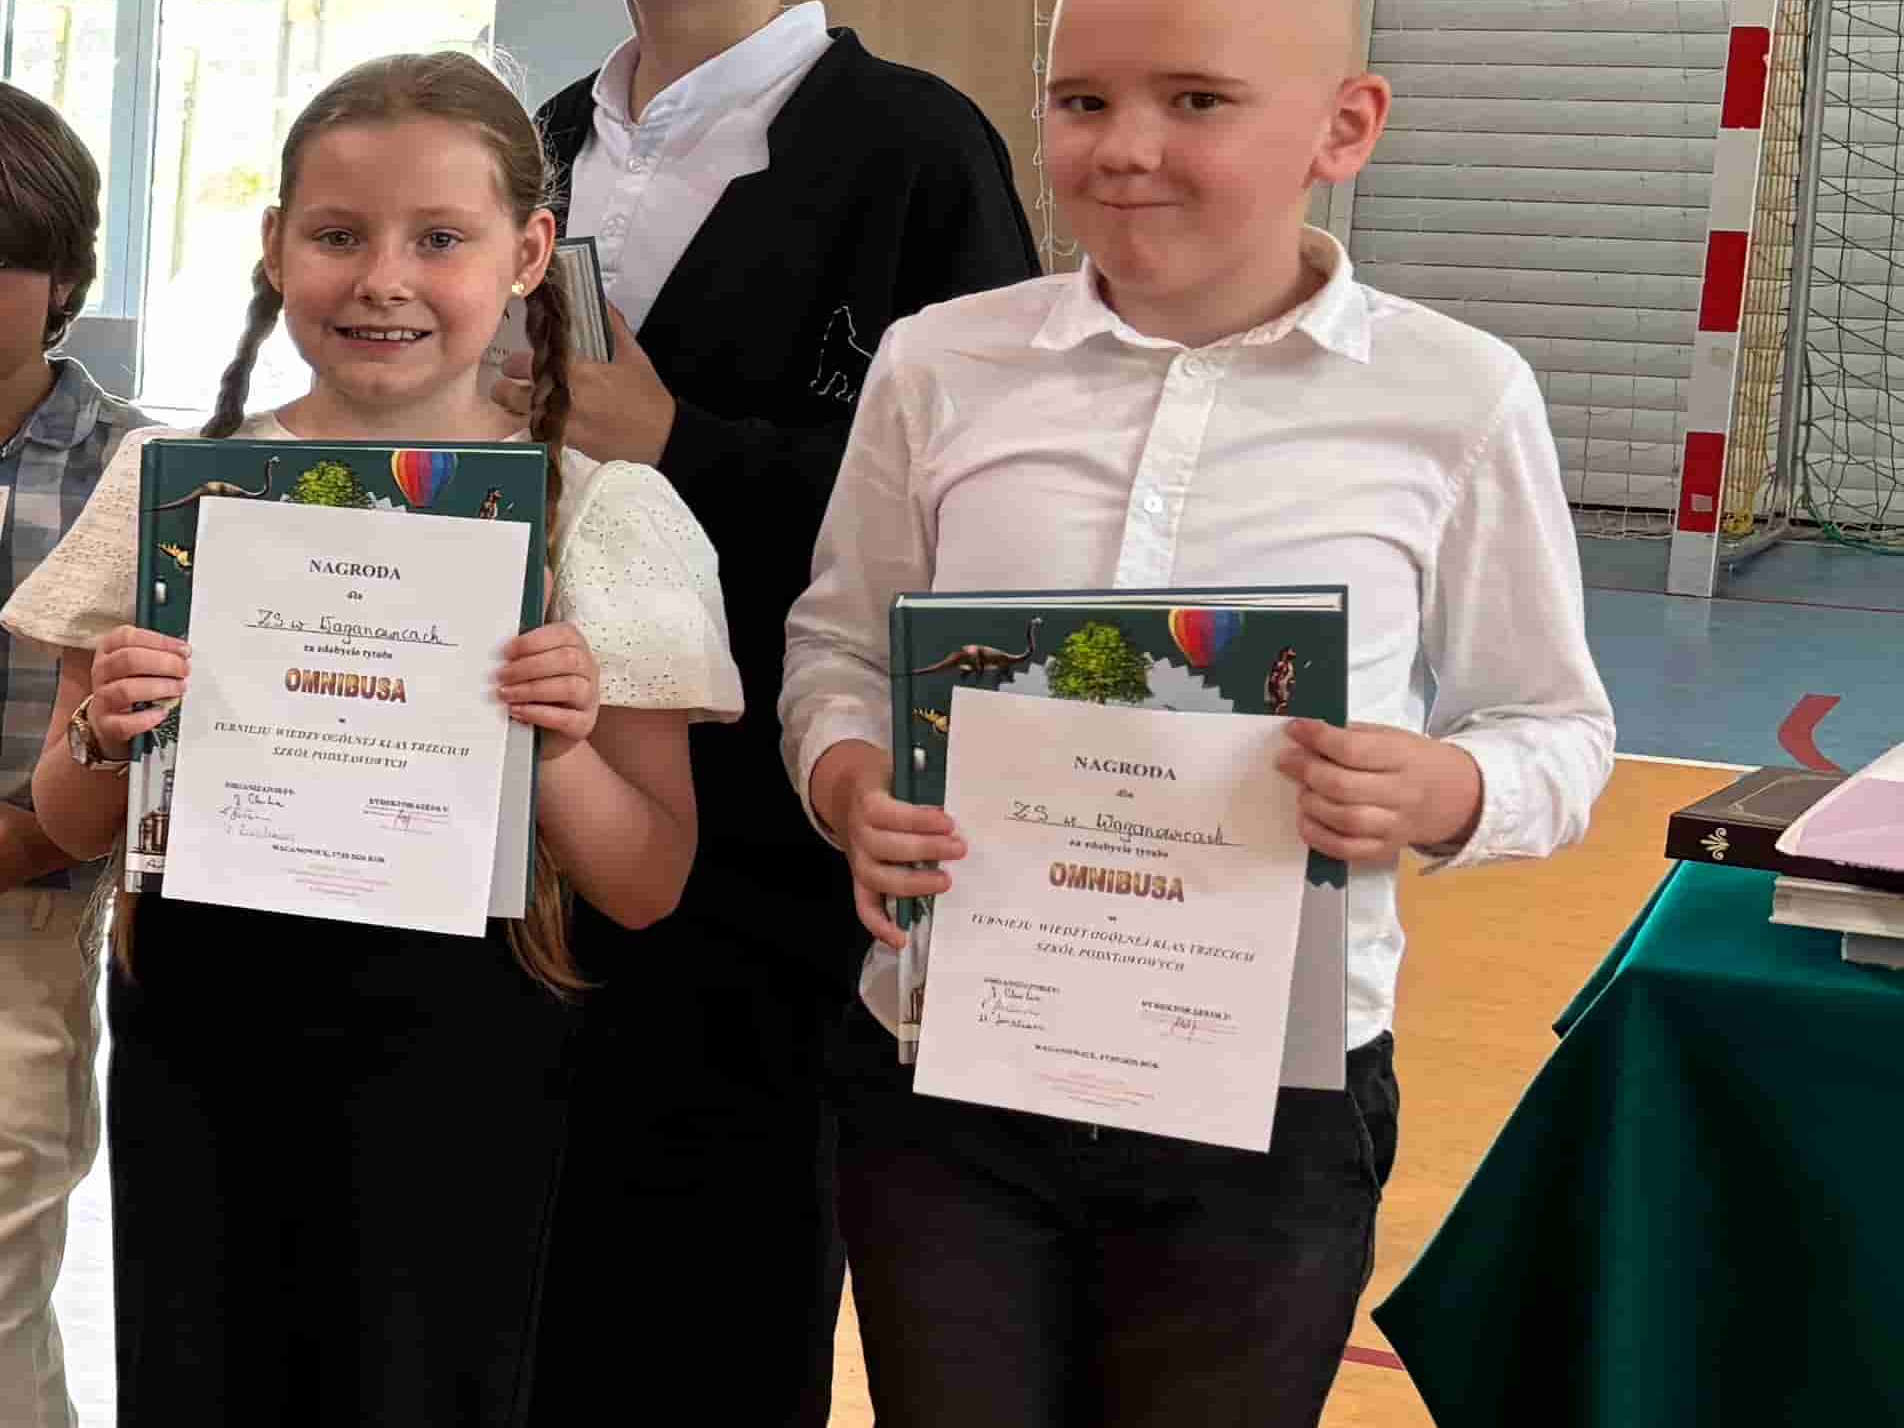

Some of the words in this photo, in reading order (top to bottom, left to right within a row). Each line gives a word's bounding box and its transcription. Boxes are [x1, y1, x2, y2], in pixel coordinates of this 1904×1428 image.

[309, 559, 401, 581] NAGRODA
[285, 668, 407, 704] OMNIBUSA
[1074, 755, 1177, 781] NAGRODA
[1049, 861, 1185, 903] OMNIBUSA
